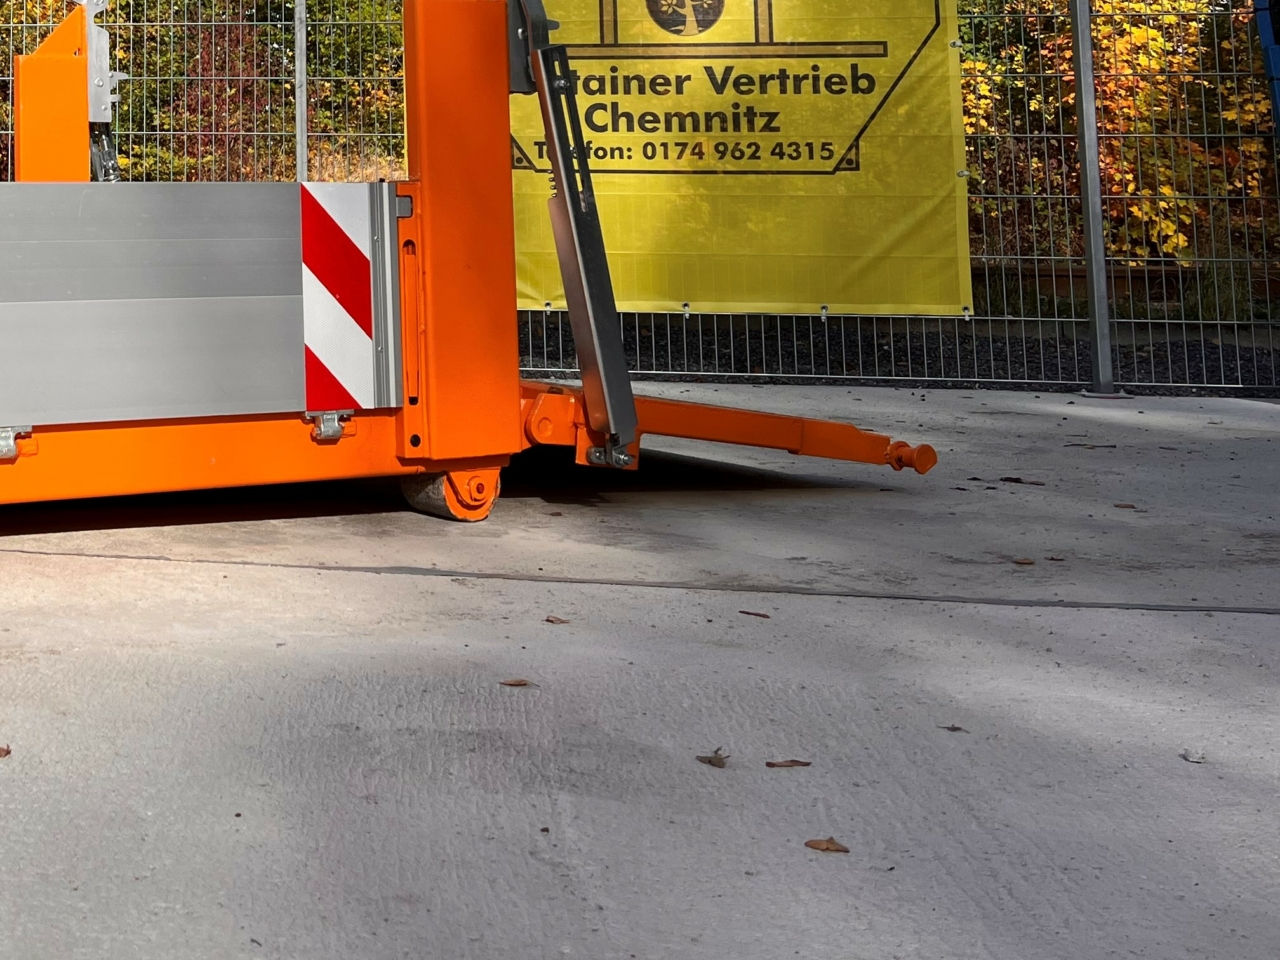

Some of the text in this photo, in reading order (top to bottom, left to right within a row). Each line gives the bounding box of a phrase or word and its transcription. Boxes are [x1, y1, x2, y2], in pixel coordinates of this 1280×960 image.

[570, 63, 876, 96] tainer Vertrieb
[584, 102, 782, 133] Chemnitz
[533, 140, 835, 161] Tfon: 0174 962 4315
